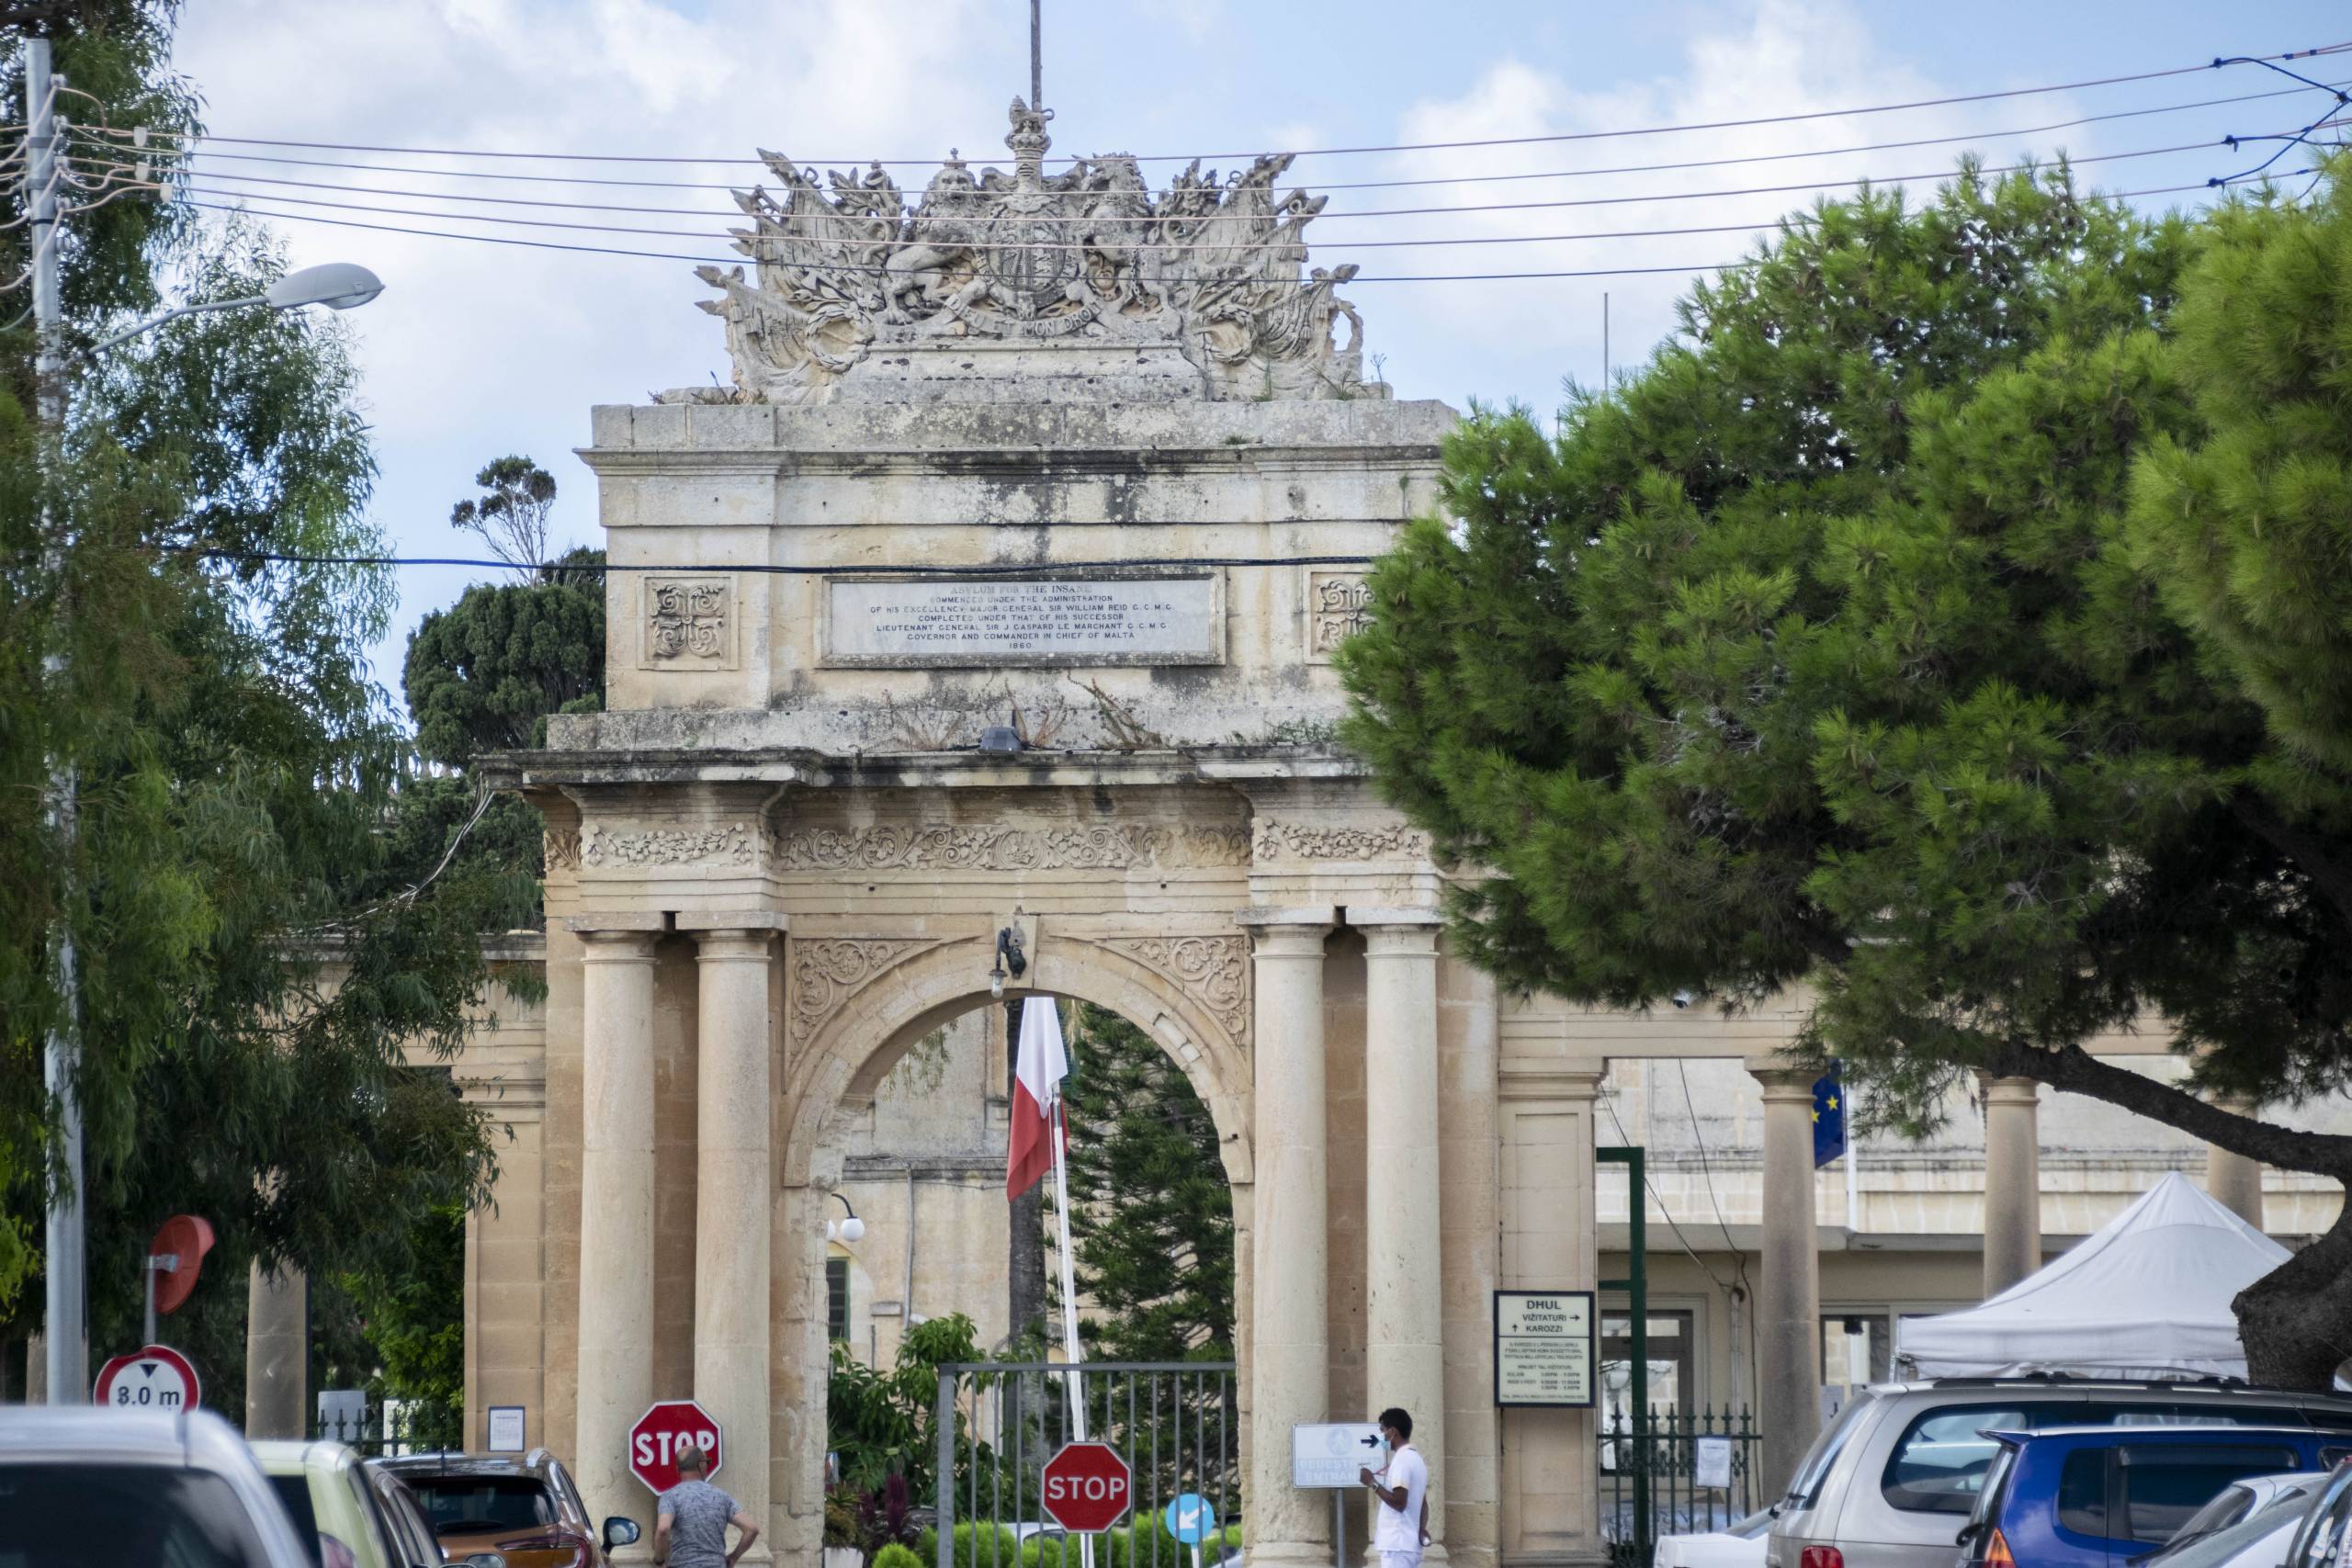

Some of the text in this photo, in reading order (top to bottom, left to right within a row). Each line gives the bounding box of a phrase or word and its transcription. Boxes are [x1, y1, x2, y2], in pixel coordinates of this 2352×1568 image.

[1023, 321, 1056, 336] MON
[950, 584, 1092, 594] ASYLUM FOR THE INSANE
[1526, 1325, 1563, 1333] KAROZZI
[159, 1391, 180, 1405] m
[636, 1430, 716, 1467] STOP
[1299, 1458, 1381, 1470] PEDESTRN
[1306, 1472, 1359, 1483] ENTRAN
[1047, 1476, 1126, 1501] STOP
